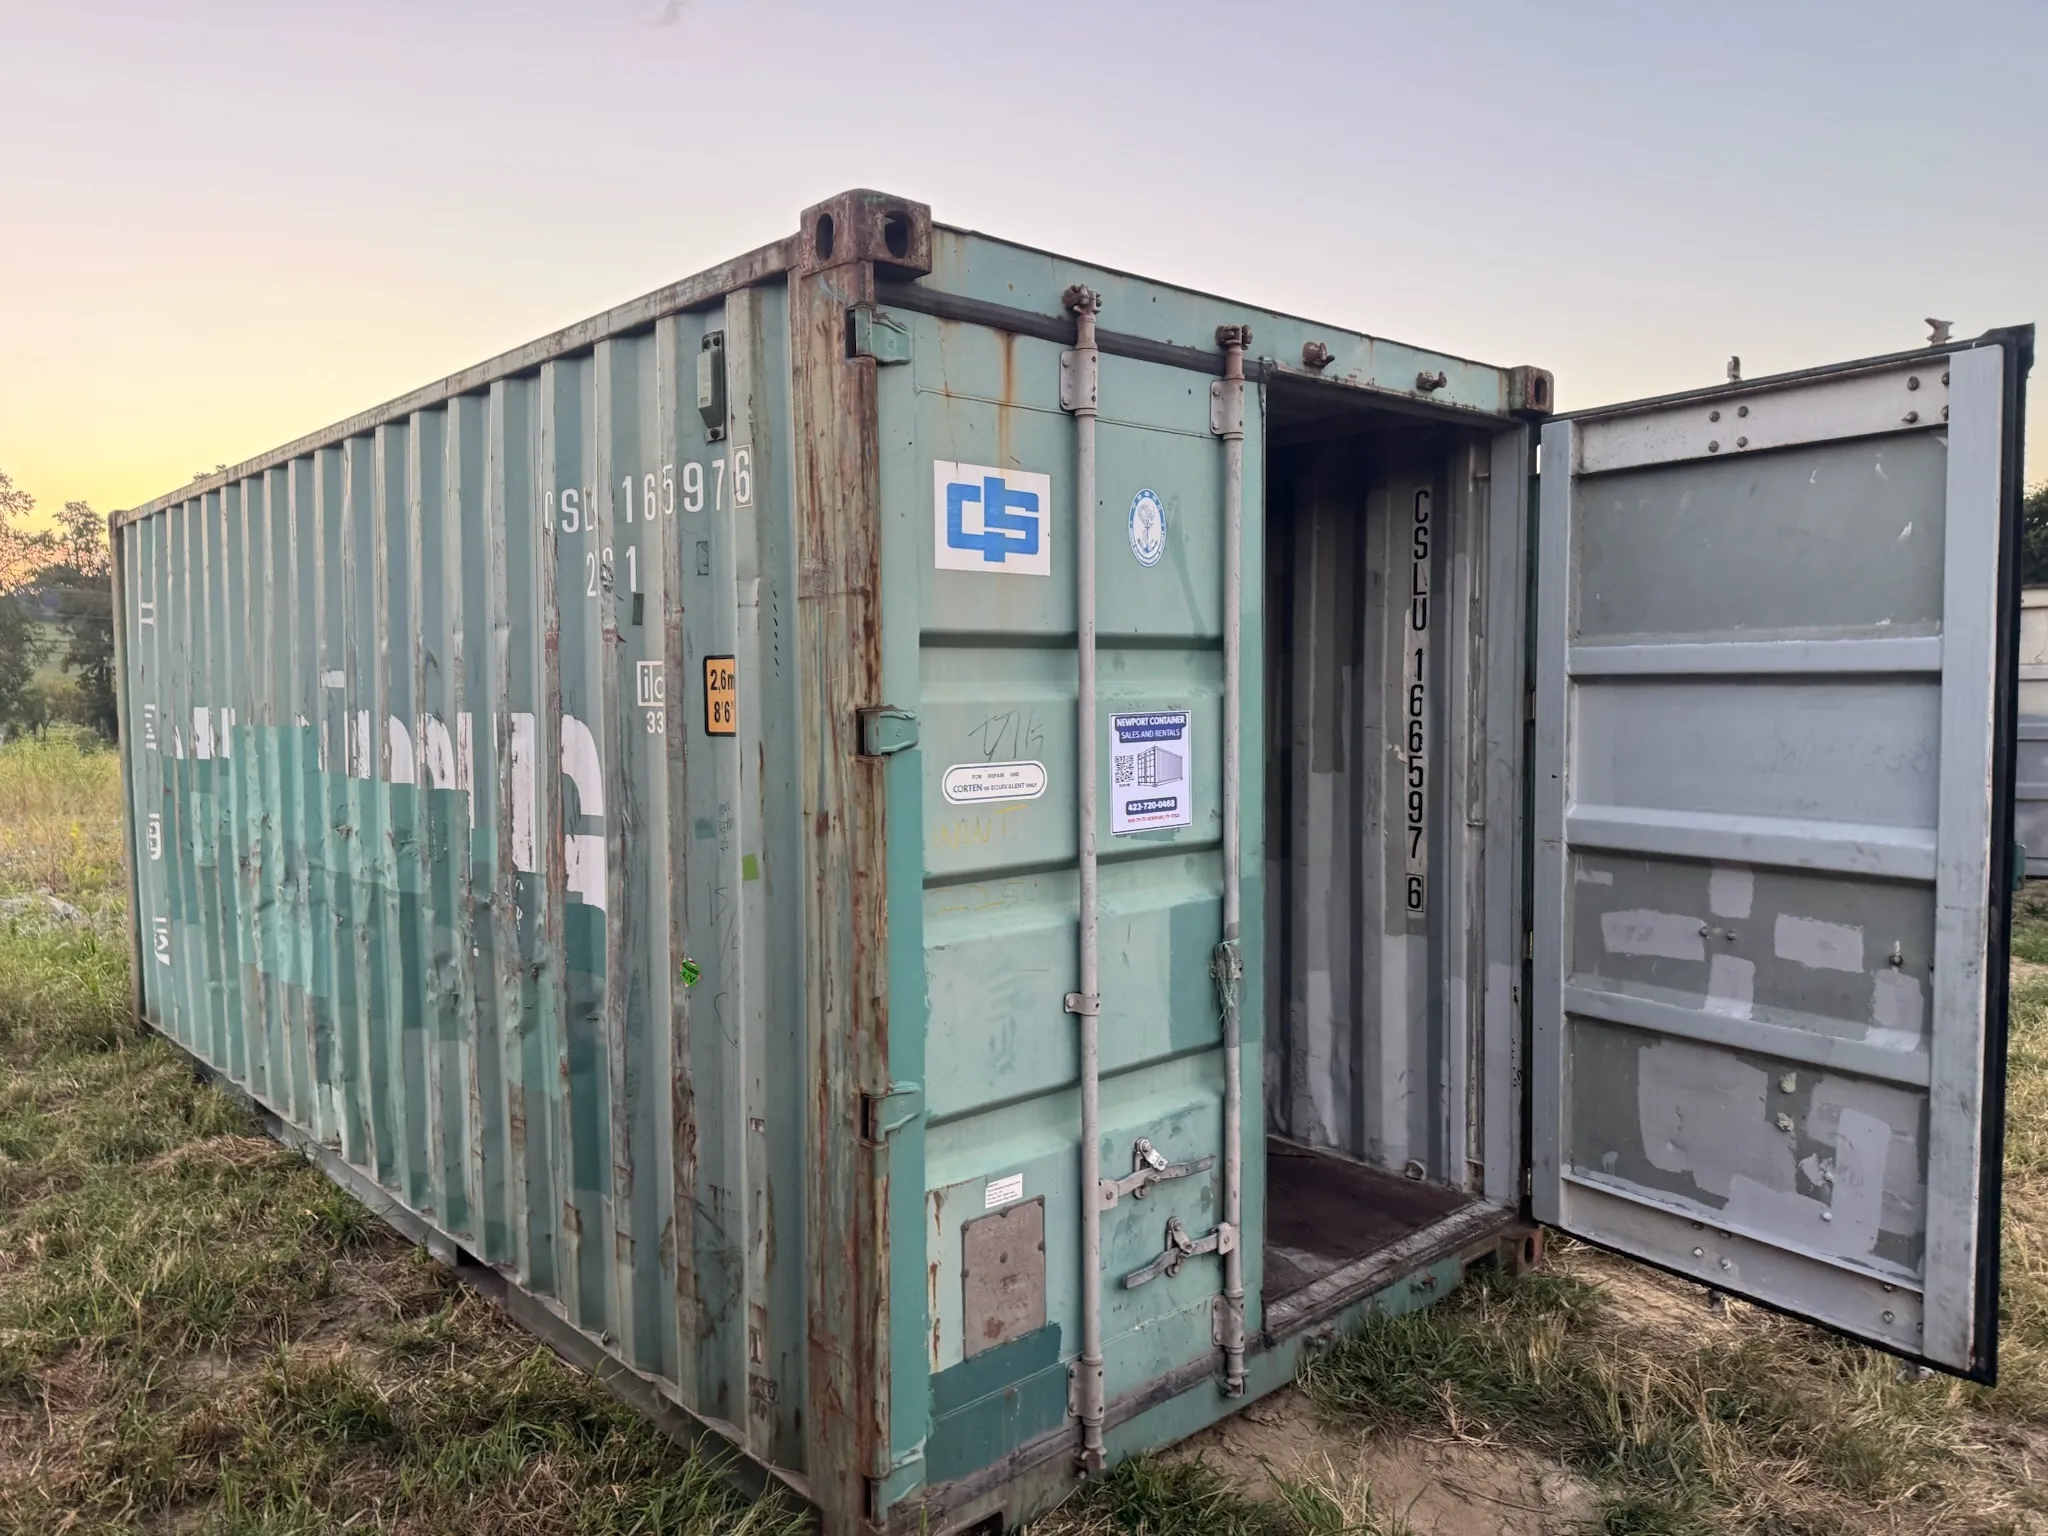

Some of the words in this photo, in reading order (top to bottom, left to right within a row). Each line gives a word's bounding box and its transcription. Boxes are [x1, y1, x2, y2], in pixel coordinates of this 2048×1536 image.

[1412, 490, 1430, 631] CSLU
[1116, 717, 1149, 727] NEWPORT
[1149, 715, 1185, 725] CONTAINER
[1121, 730, 1140, 739] SALES
[1140, 730, 1154, 738] AND
[1155, 728, 1180, 737] RENTALS
[953, 784, 982, 793] CORTEN
